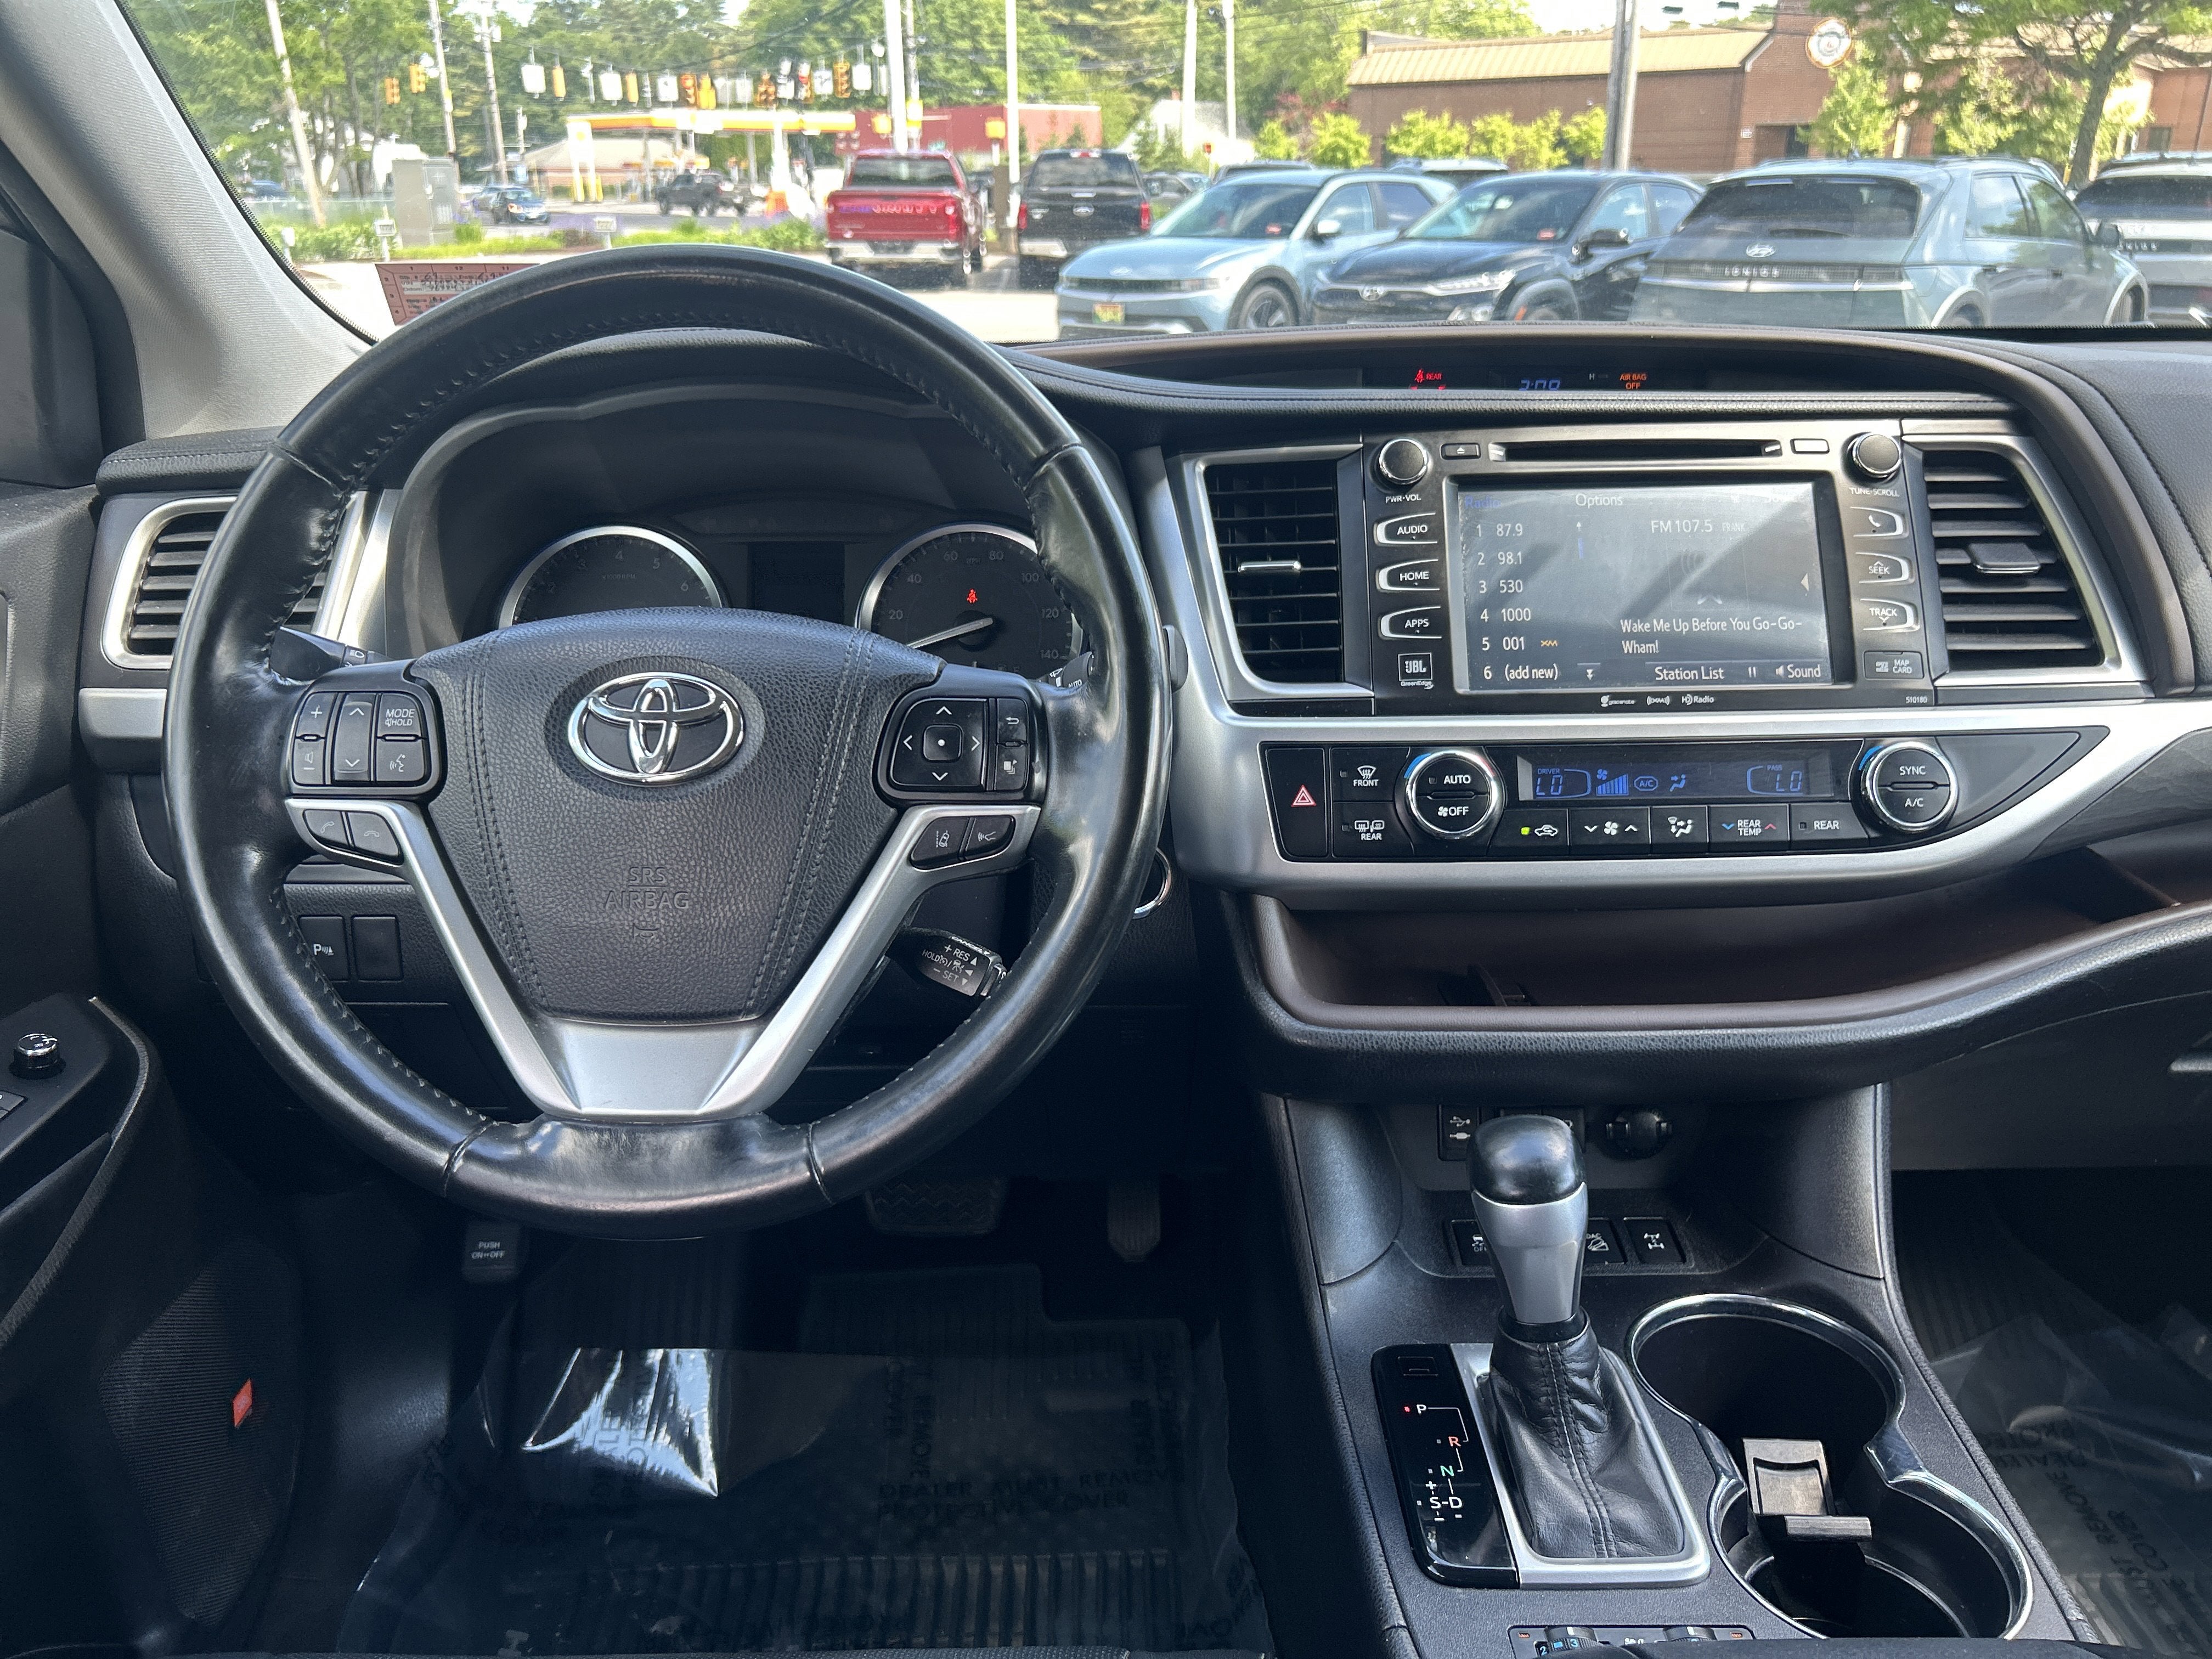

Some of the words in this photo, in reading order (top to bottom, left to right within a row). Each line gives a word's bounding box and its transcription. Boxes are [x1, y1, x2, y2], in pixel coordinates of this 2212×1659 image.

[1575, 493, 1623, 509] Options
[1397, 524, 1428, 535] AUDIO
[1476, 524, 1481, 537] 1
[1496, 523, 1523, 537] 87.9
[1651, 520, 1672, 533] FM
[1675, 519, 1713, 533] 107.5
[943, 551, 958, 561] 60
[989, 551, 1004, 561] 80
[1477, 552, 1486, 566] 2
[1497, 551, 1523, 565] 98.1
[652, 557, 661, 569] 5
[1868, 566, 1890, 574] SEEK
[907, 574, 922, 584] 40
[1021, 572, 1040, 582] 100
[1400, 571, 1429, 582] HOME
[1479, 580, 1487, 594] 3
[1499, 579, 1523, 593] 530
[889, 609, 904, 619] 20
[1041, 608, 1059, 618] 120
[1480, 608, 1489, 622] 4
[1501, 608, 1531, 622] 1000
[1870, 607, 1897, 617] TRACK
[1404, 618, 1429, 628] APPS
[1620, 619, 1650, 633] Wake
[1653, 619, 1671, 632] Me
[1673, 618, 1689, 635] Up
[1692, 618, 1727, 631] Before
[1730, 617, 1750, 631] You
[1482, 637, 1491, 651] 5
[1502, 636, 1525, 651] 001
[1622, 640, 1660, 655] Wham!
[1483, 666, 1492, 680] 6
[1504, 663, 1529, 682] (add
[1532, 663, 1559, 681] new)
[1655, 665, 1698, 681] Station
[1701, 665, 1724, 680] List
[1787, 664, 1821, 679] Sound
[386, 708, 415, 718] MODE
[1899, 766, 1926, 775] SYNC
[1443, 774, 1471, 785] AUTO
[1904, 797, 1923, 808] A/C
[1449, 806, 1469, 816] OFF
[1737, 819, 1760, 828] REAR
[1814, 820, 1839, 830] REAR
[1737, 827, 1762, 837] TEMP
[628, 866, 667, 884] SRS
[605, 890, 689, 909] AIRBAG
[922, 949, 940, 963] HOLD
[953, 947, 970, 962] RES
[942, 969, 960, 983] SET
[478, 1241, 500, 1249] PUSH
[1417, 1404, 1426, 1414] P
[1448, 1436, 1462, 1447] R
[1441, 1465, 1454, 1477] N
[1570, 1638, 1578, 1647] 3
[1540, 1645, 1549, 1657] 2
